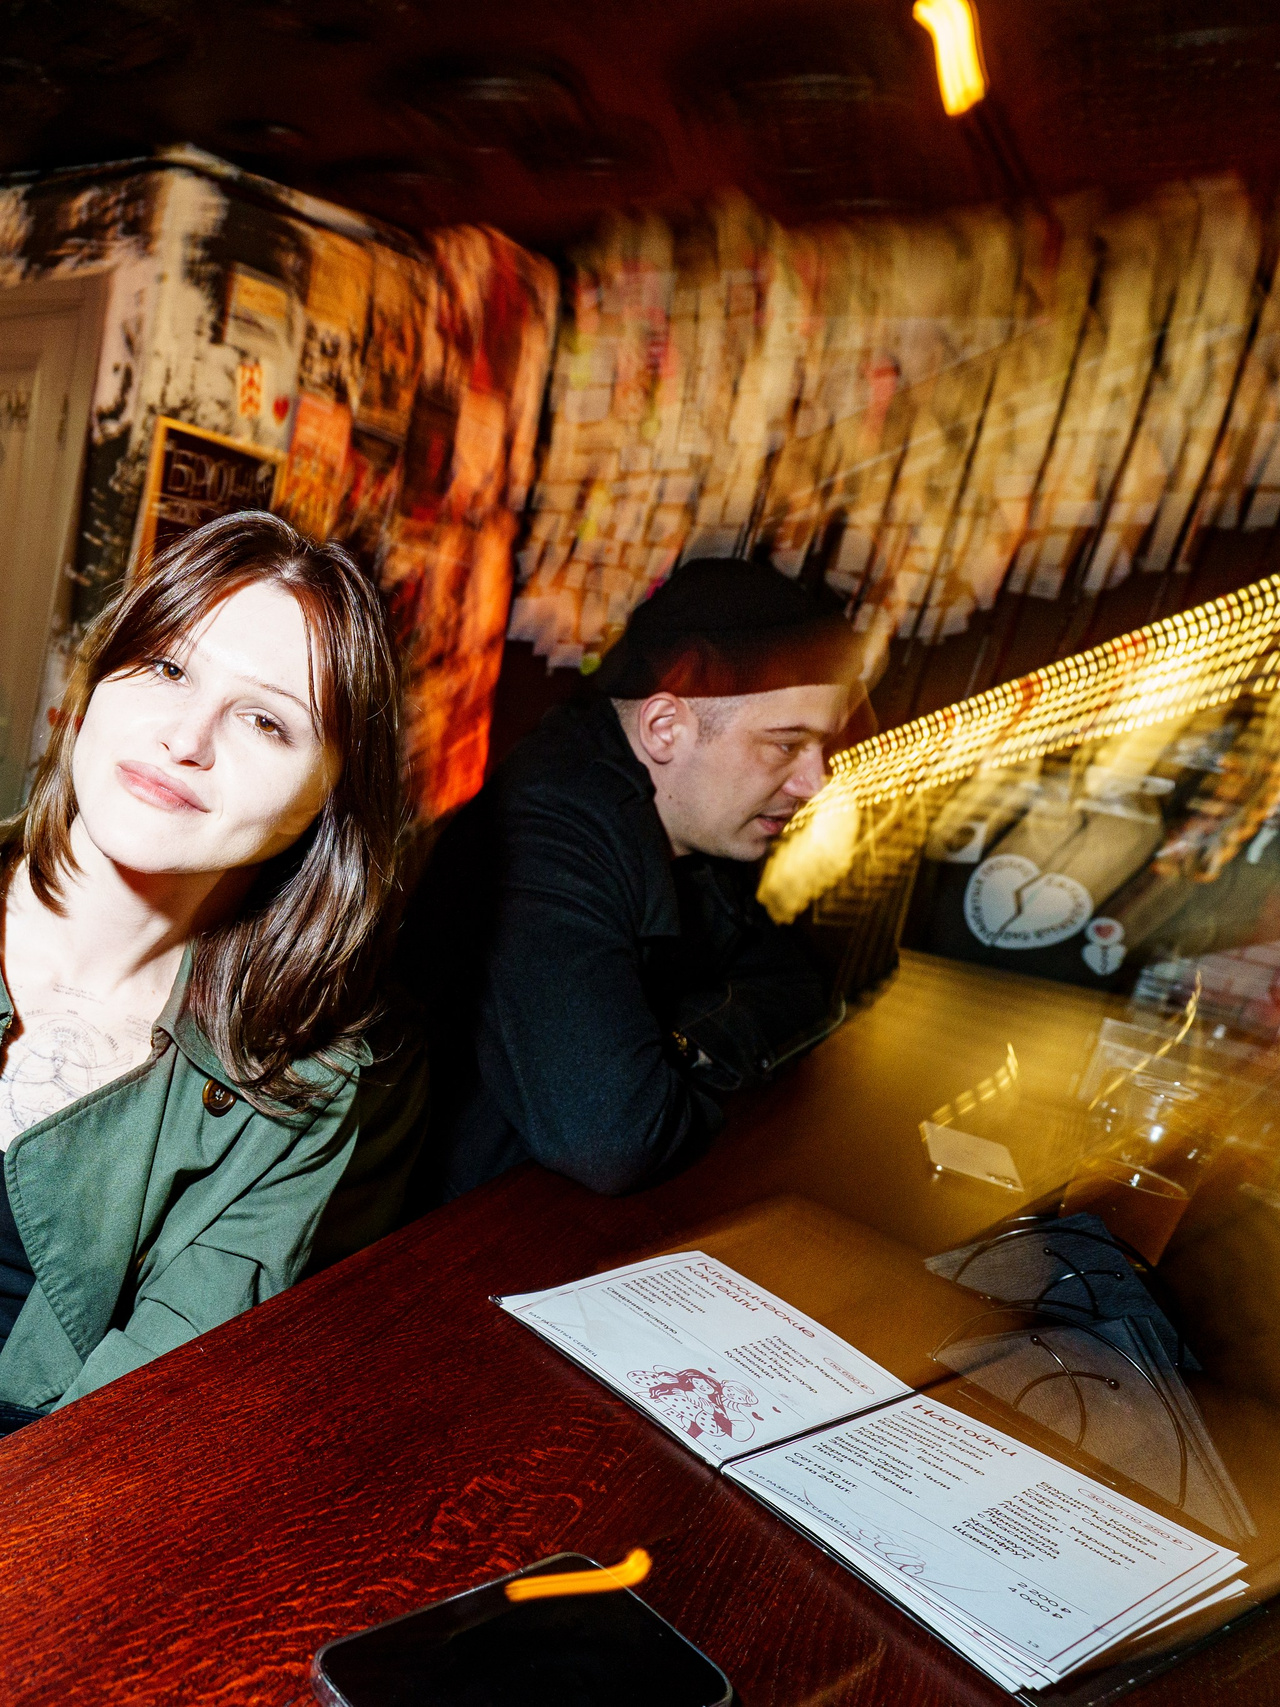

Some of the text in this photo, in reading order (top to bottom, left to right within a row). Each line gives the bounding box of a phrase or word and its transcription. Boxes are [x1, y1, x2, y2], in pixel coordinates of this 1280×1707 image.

[621, 1282, 656, 1304] Дайкири
[631, 1279, 672, 1307] Маргарита
[655, 1272, 690, 1296] Ром-кола
[659, 1290, 694, 1313] Мартини
[663, 1270, 706, 1299] Виски-кола
[671, 1290, 705, 1313] Мартини
[684, 1265, 758, 1311] коктейли
[697, 1262, 815, 1338] Классические
[606, 1286, 677, 1334] Свидание вслепую
[724, 1350, 761, 1378] Кузнечик
[732, 1347, 774, 1379] Мичелада
[740, 1345, 791, 1383] Блади Мэри
[756, 1340, 793, 1367] Негрони
[765, 1337, 782, 1351] Олд
[748, 1342, 818, 1394] Нью-Йорк сауэр
[772, 1335, 853, 1394] Порнстар Мартини
[852, 1429, 887, 1447] Лимон
[868, 1422, 908, 1444] Малина
[916, 1447, 944, 1462] Личи
[877, 1419, 985, 1476] Ванильный пломбир
[883, 1417, 942, 1448] Смородина
[892, 1413, 983, 1460] Сливочная Барби
[900, 1410, 993, 1457] Сливочный Банан
[912, 1404, 1016, 1456] Настойки
[793, 1452, 858, 1489] Сет из 10 шт.
[812, 1444, 843, 1463] Пихта
[820, 1442, 863, 1467] Черника
[871, 1470, 912, 1494] Корица
[828, 1438, 904, 1479] Электроцветы
[834, 1436, 869, 1455] Вишня
[877, 1458, 912, 1478] Орехи
[845, 1432, 913, 1470] Черноплодка
[923, 1472, 950, 1490] Чили
[859, 1426, 908, 1453] Клубника
[916, 1455, 961, 1481] Базилик
[784, 1455, 850, 1493] Сет из 20 шт.
[748, 1469, 765, 1479] БАР
[811, 1505, 846, 1528] СЕРДЕЦ
[998, 1503, 1050, 1533] Лаванда
[1021, 1490, 1053, 1509] Кофе
[1035, 1484, 1081, 1510] Специи
[1091, 1514, 1150, 1545] Каркаде
[1040, 1481, 1098, 1514] Брусника
[1109, 1518, 1158, 1546] Клюква
[952, 1525, 1000, 1555] Щавель
[961, 1520, 1029, 1559] Грейпфрут
[968, 1517, 1035, 1557] Хреновуха
[982, 1510, 1060, 1555] Лимончелла
[986, 1518, 1057, 1559] Жасмином
[987, 1507, 1058, 1547] Древесная
[1003, 1500, 1063, 1533] Апельсин
[1074, 1538, 1121, 1565] Инжир
[1012, 1495, 1059, 1522] Персик
[1069, 1526, 1135, 1564] Маракуйя
[1027, 1488, 1070, 1513] Свекла
[1081, 1517, 1157, 1560] Смородина
[1106, 1504, 1123, 1514] мл
[1125, 1514, 1142, 1524] по
[1143, 1524, 1173, 1538] 250
[1019, 1593, 1050, 1612] 000
[1028, 1588, 1059, 1607] 200
[1027, 1640, 1039, 1648] 13
